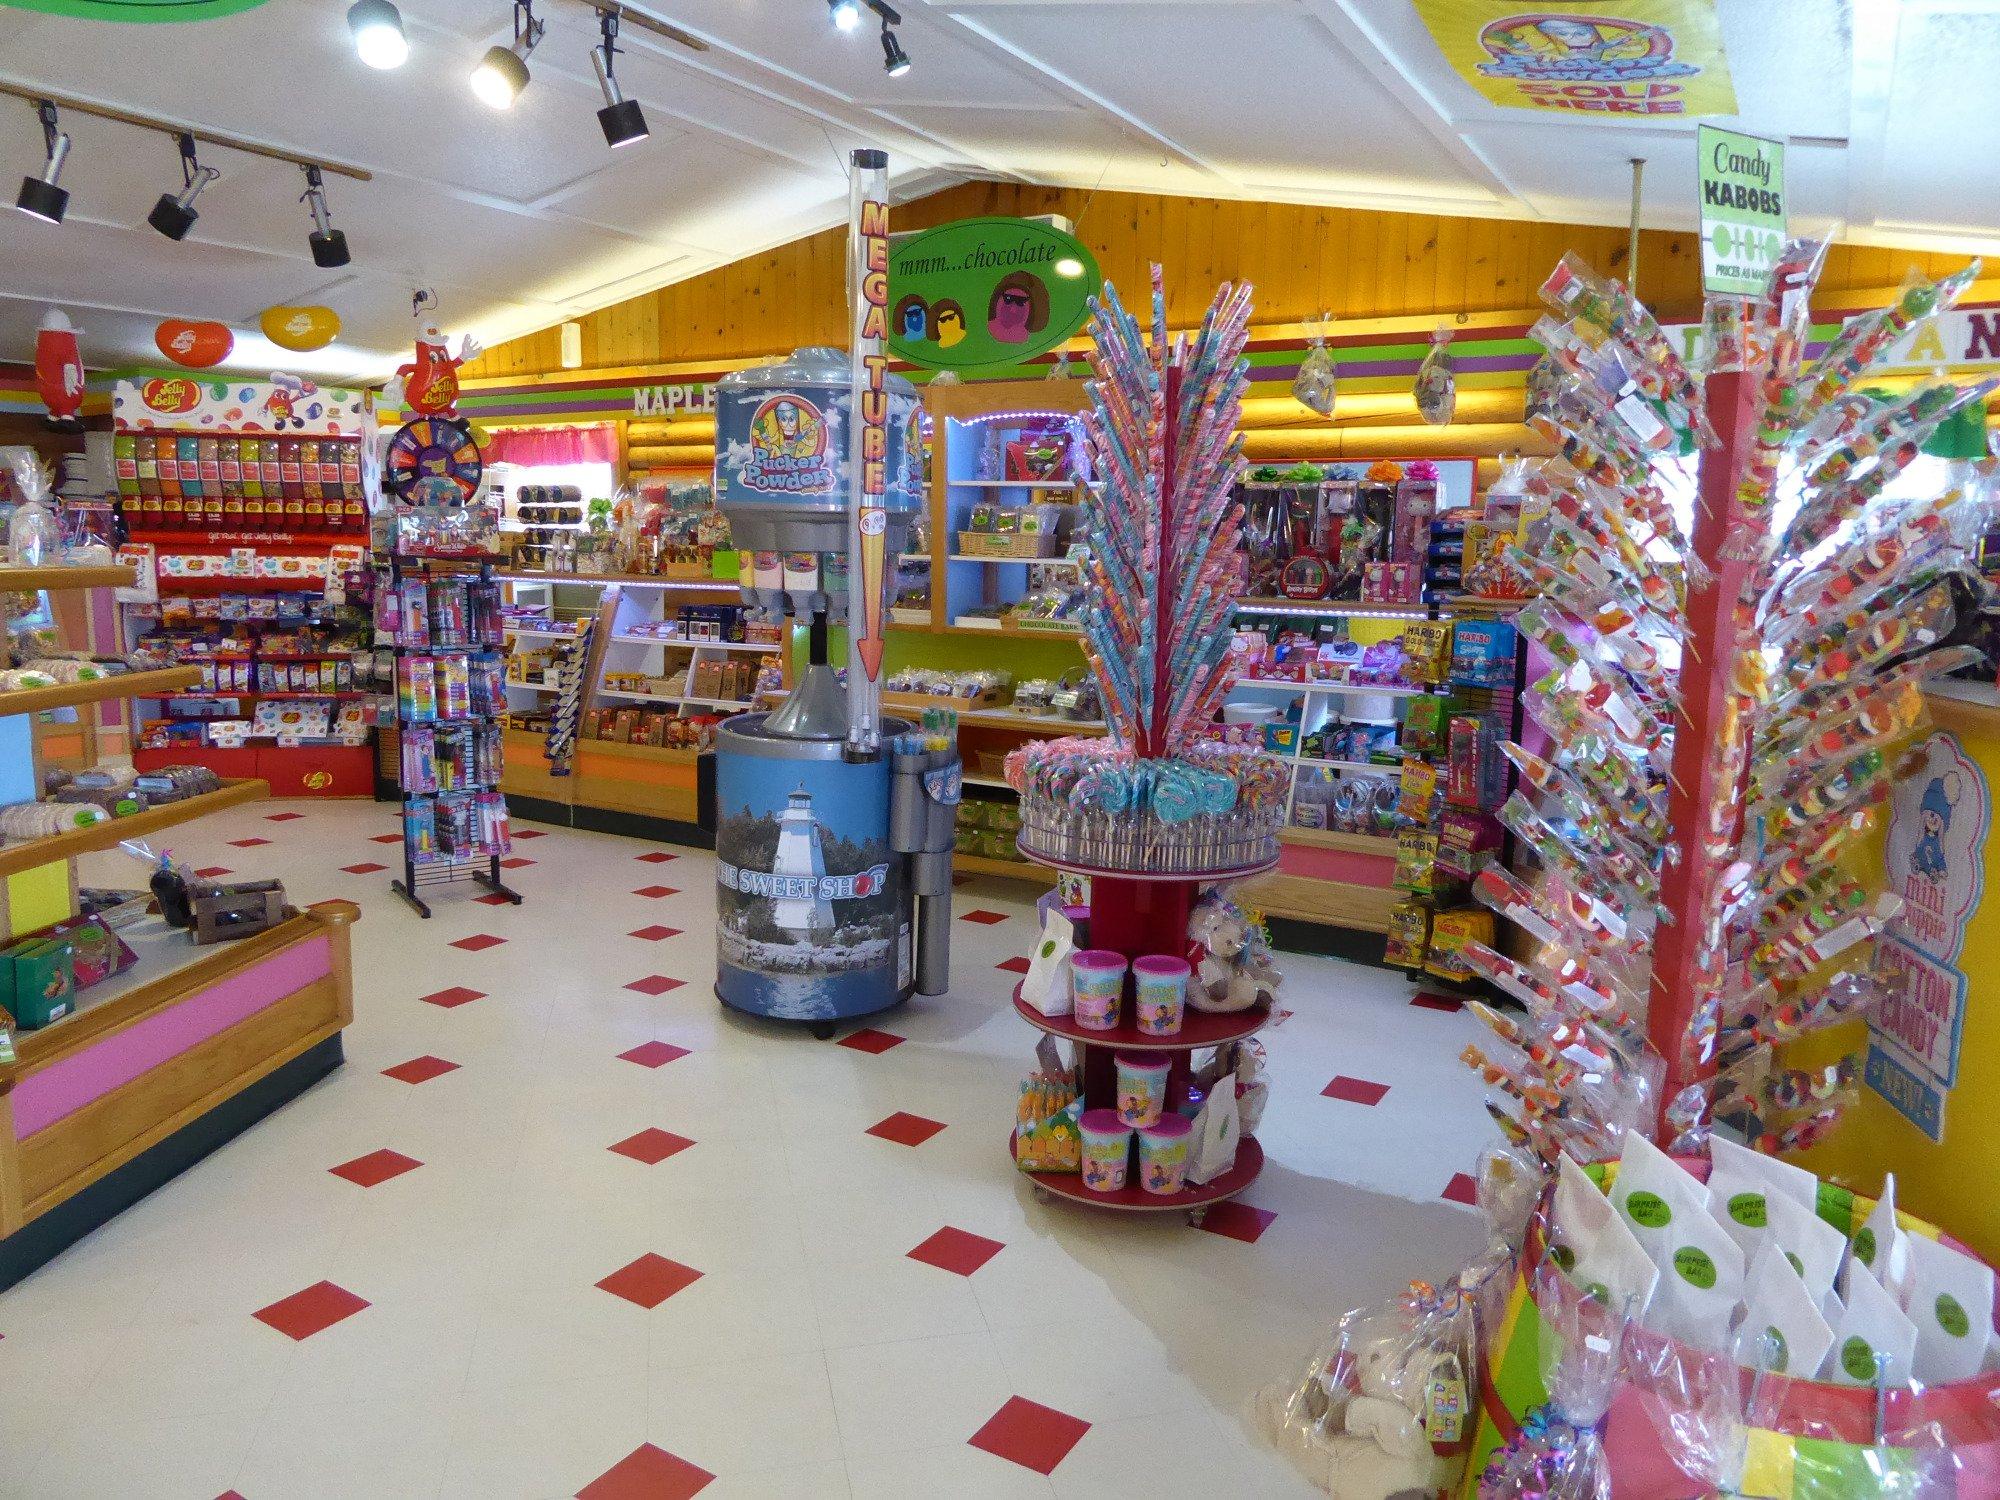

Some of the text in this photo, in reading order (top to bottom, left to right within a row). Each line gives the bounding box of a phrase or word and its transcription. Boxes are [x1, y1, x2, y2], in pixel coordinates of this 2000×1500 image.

[1516, 83, 1684, 99] SOLD
[1530, 97, 1684, 114] HERE
[1714, 142, 1770, 186] Candy
[1704, 179, 1781, 215] KABOBS
[861, 200, 889, 495] MEGA TUBE
[160, 382, 186, 397] Jelly
[152, 394, 181, 406] Belly
[633, 385, 716, 416] MAPLE
[752, 447, 823, 471] Pucker
[1407, 626, 1443, 639] HARIBO
[1459, 632, 1491, 643] HARIBO
[1404, 765, 1431, 781] HARIBO
[1400, 839, 1433, 851] HARIBO
[739, 868, 818, 899] SWEET
[818, 863, 889, 899] SHOP
